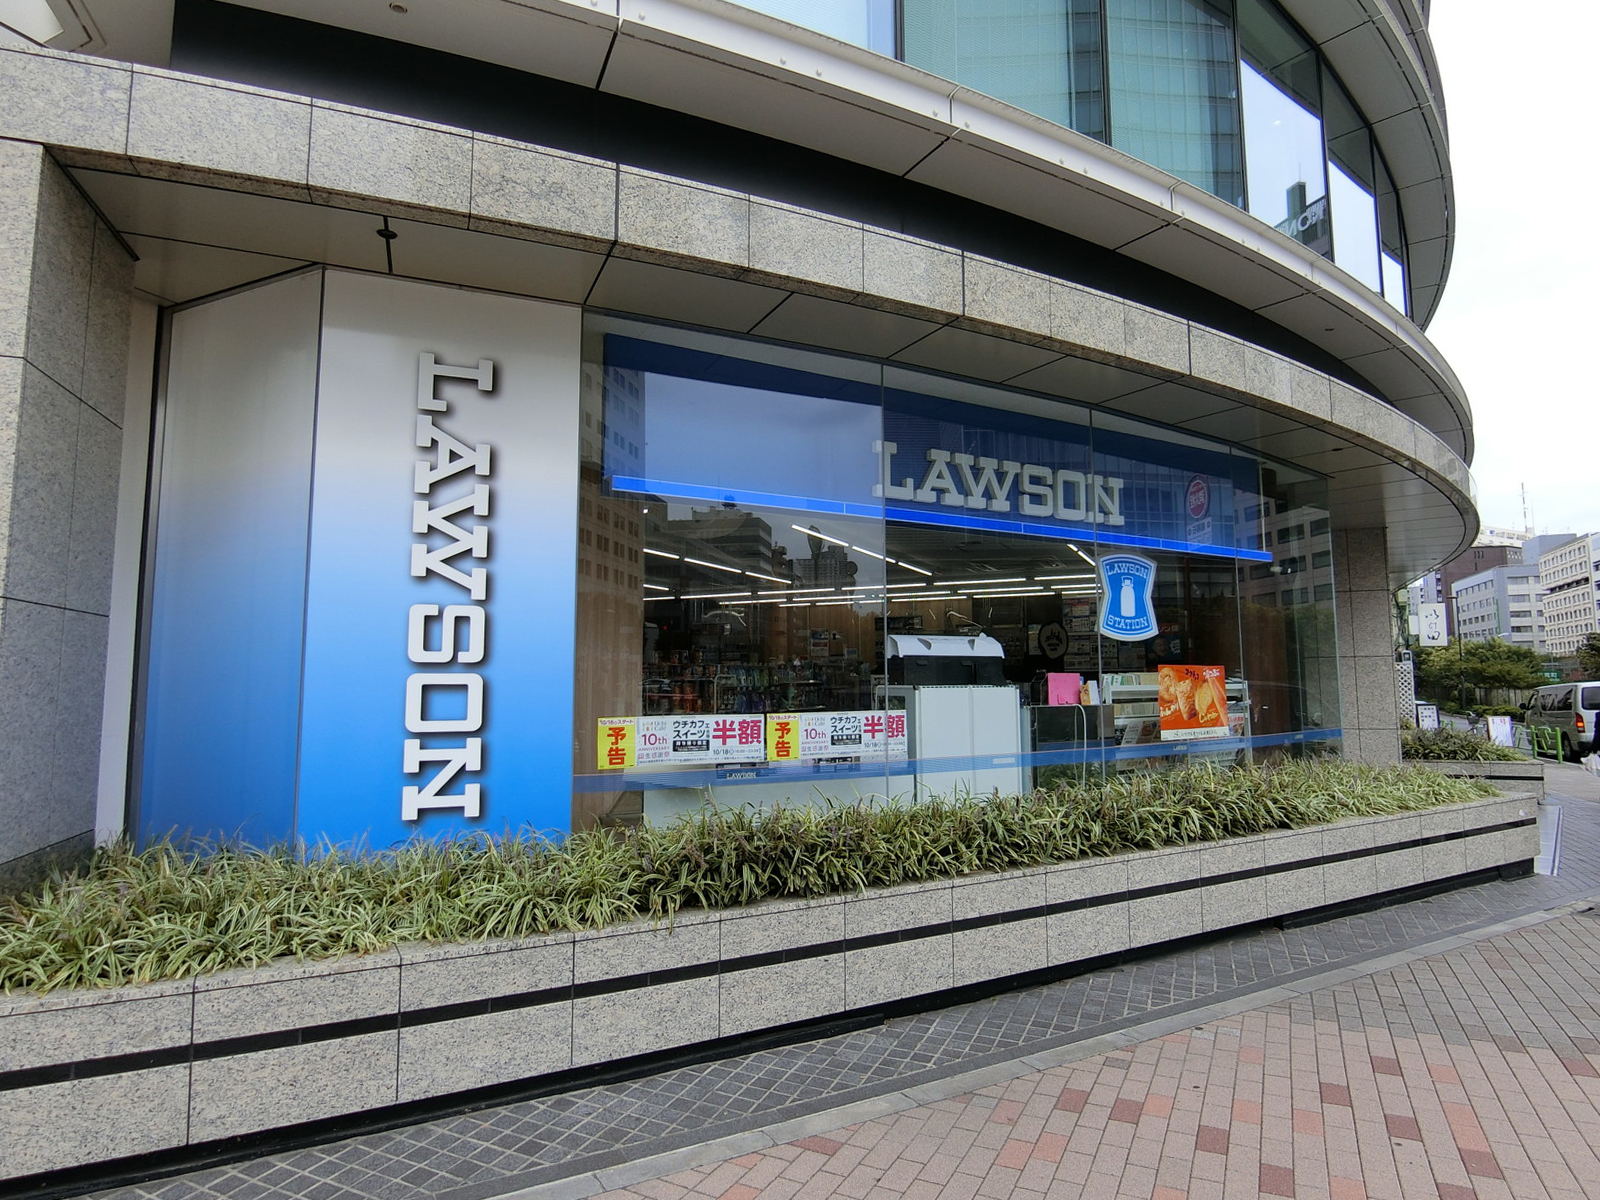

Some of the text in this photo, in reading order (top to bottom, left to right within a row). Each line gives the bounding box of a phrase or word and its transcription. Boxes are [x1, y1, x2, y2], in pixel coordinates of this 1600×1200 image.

[872, 440, 1125, 526] LAWSON
[1106, 562, 1148, 579] LAWSON
[402, 352, 494, 821] LAWSON
[1107, 614, 1149, 630] STATION
[672, 720, 710, 729] ウチカフェ
[712, 719, 762, 746] 半額
[830, 725, 858, 734] スイーツ
[863, 715, 906, 740] 半額
[642, 733, 668, 746] 10th
[672, 729, 706, 739] スイーツ
[775, 722, 792, 758] 予告
[804, 728, 827, 740] 10th
[606, 726, 627, 766] 予告
